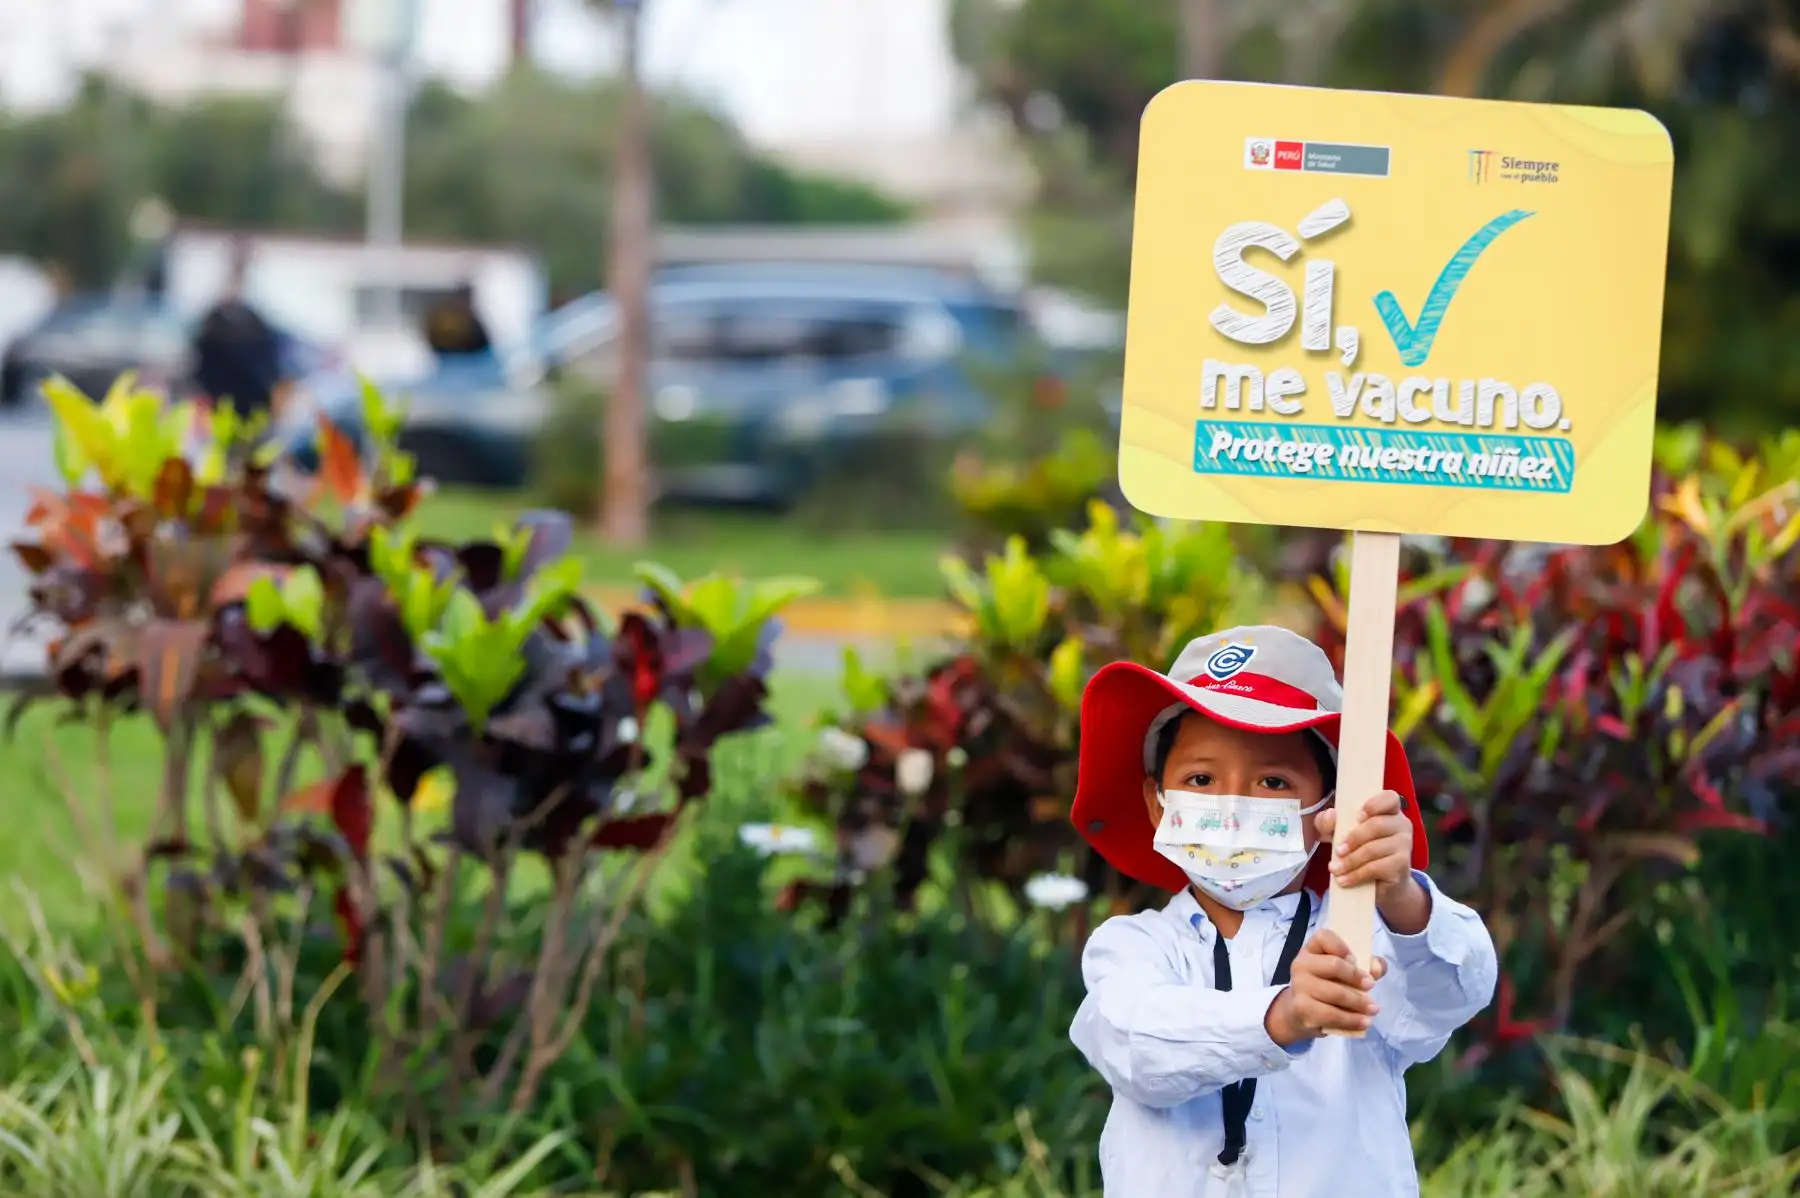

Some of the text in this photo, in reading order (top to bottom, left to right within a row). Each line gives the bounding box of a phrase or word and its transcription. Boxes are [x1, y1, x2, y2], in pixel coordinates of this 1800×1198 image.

[1277, 148, 1301, 161] PERÚ
[1501, 156, 1559, 173] Siempre
[1521, 172, 1559, 184] pueblo
[1208, 197, 1360, 367] Sí,
[1200, 358, 1572, 430] me vacuno.
[1208, 430, 1556, 480] Protege nuestra niñez
